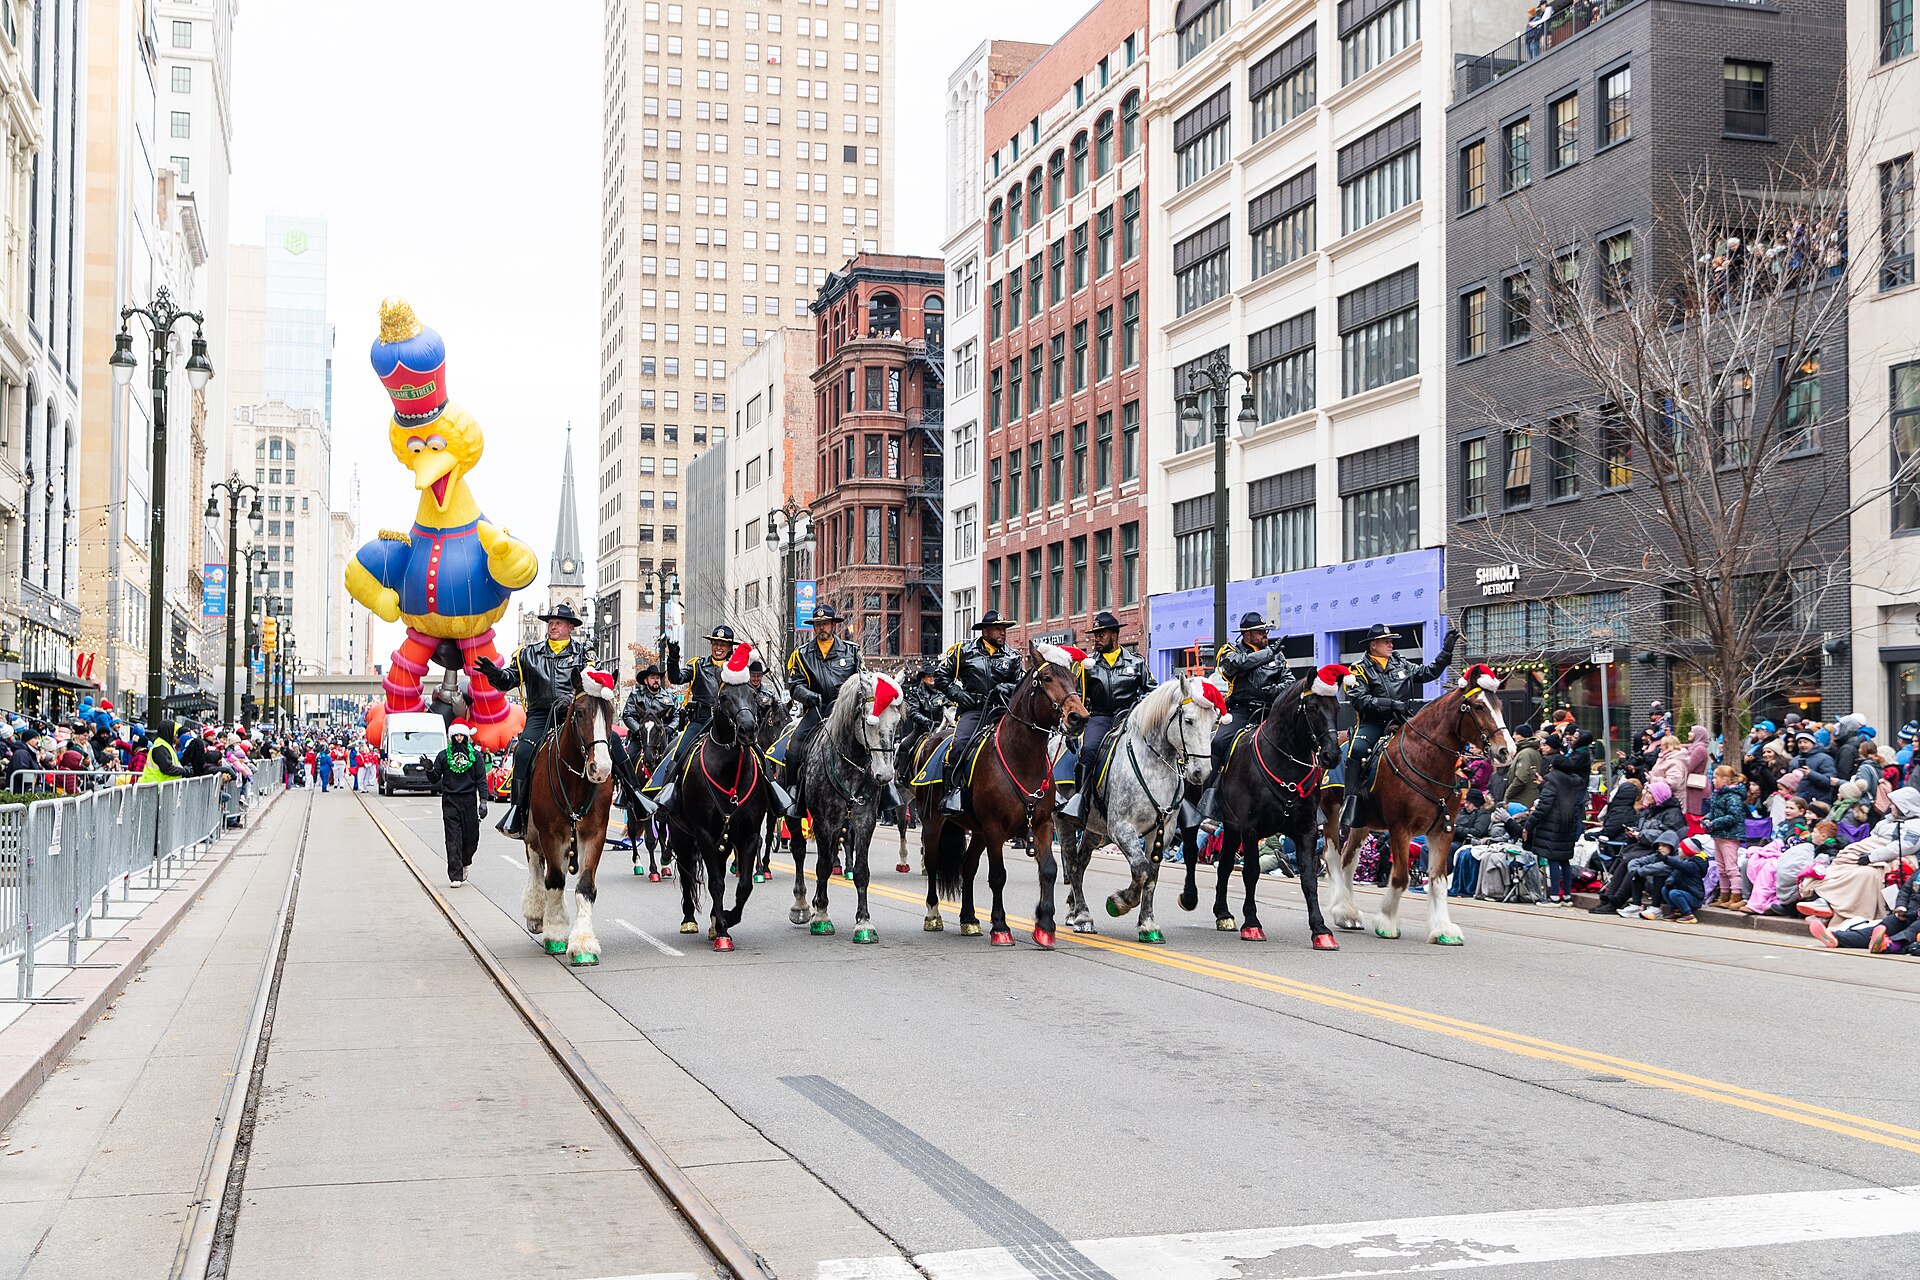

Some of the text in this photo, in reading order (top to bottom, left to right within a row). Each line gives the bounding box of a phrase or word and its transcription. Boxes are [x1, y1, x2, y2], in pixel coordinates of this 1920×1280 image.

[411, 384, 433, 398] STREET
[1475, 564, 1520, 585] SHINOLA
[1482, 582, 1514, 596] DETROIT
